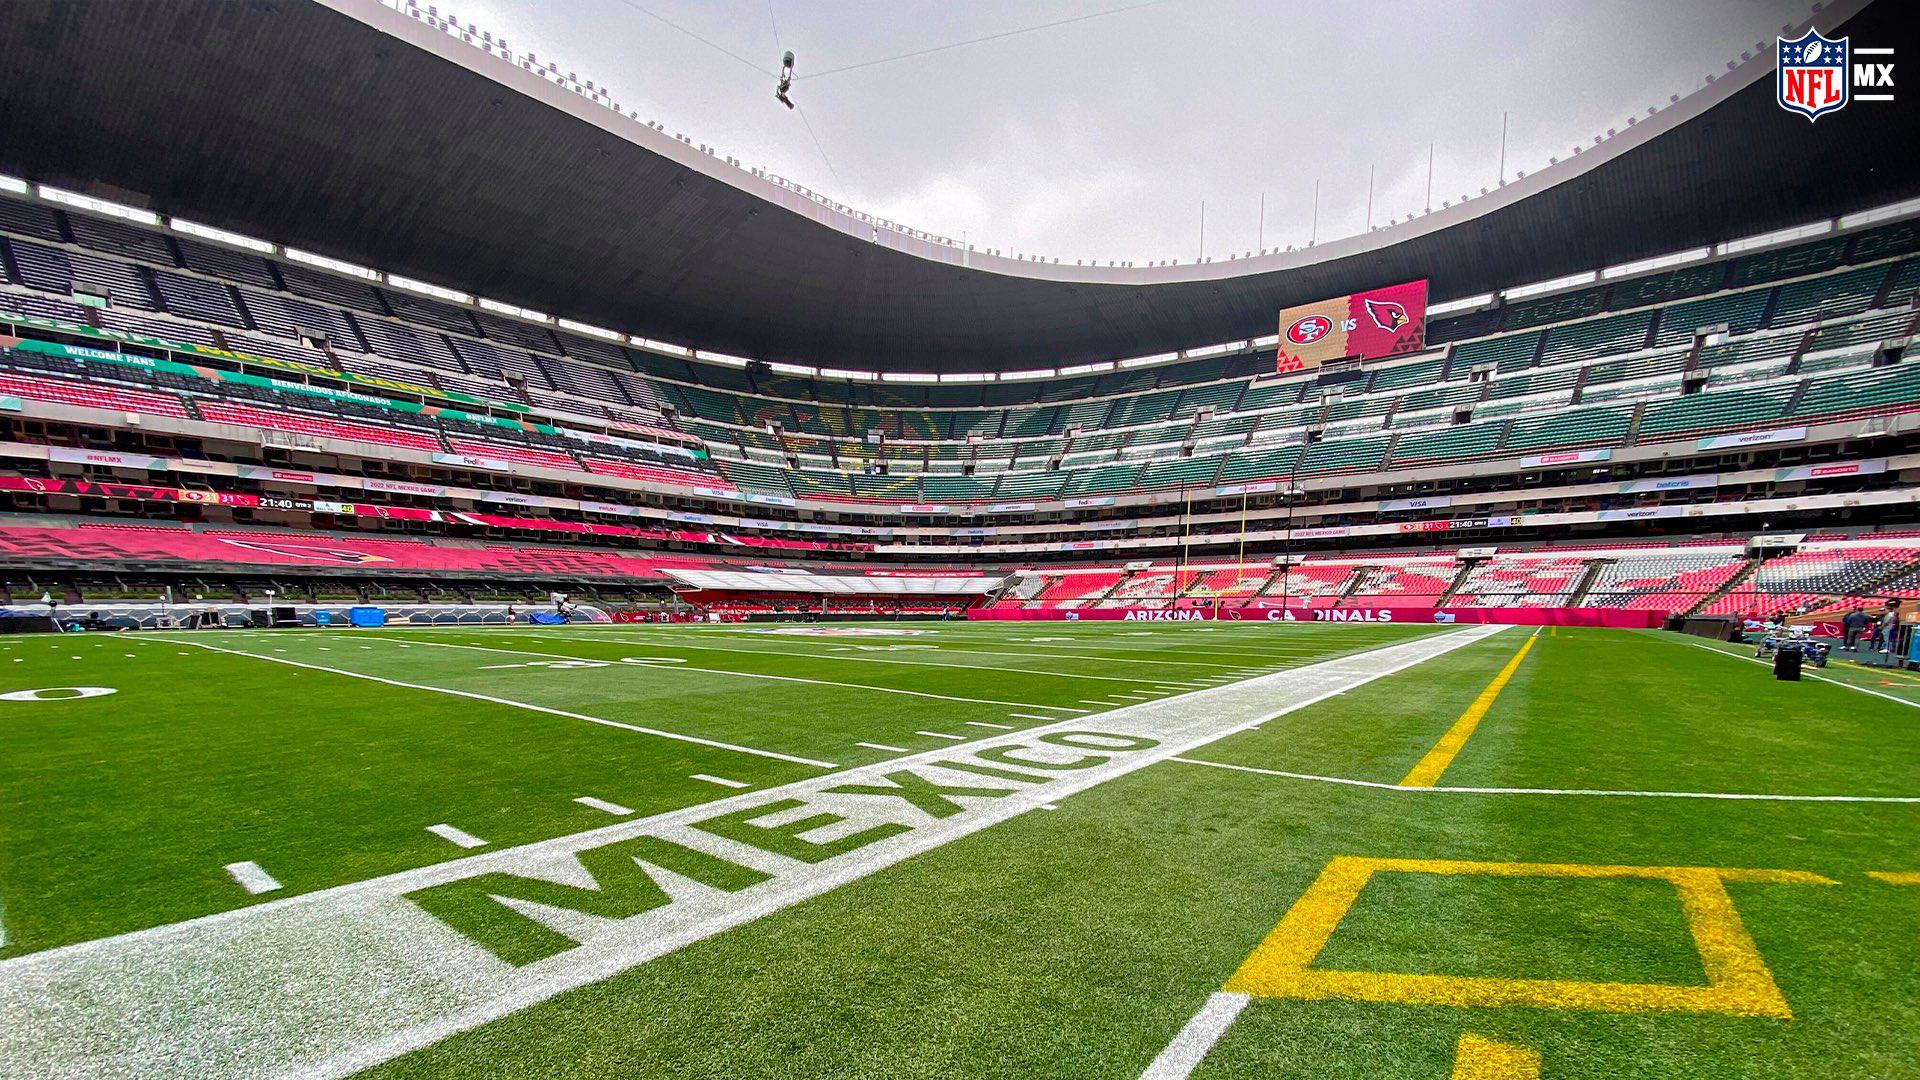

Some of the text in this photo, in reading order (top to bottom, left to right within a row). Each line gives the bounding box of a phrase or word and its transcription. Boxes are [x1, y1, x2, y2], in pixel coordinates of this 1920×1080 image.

[63, 344, 156, 367] WELCOME FANS
[271, 378, 392, 406] BIENVENIDOS AFICIONADOS
[1738, 434, 1771, 442] verizon
[463, 457, 486, 466] FedEx
[1656, 481, 1689, 489] betcris
[260, 498, 292, 508] 21:40
[1450, 521, 1472, 529] 21:40
[1124, 609, 1392, 622] ARIZONA CADINALS
[403, 731, 1161, 966] MEXICO
